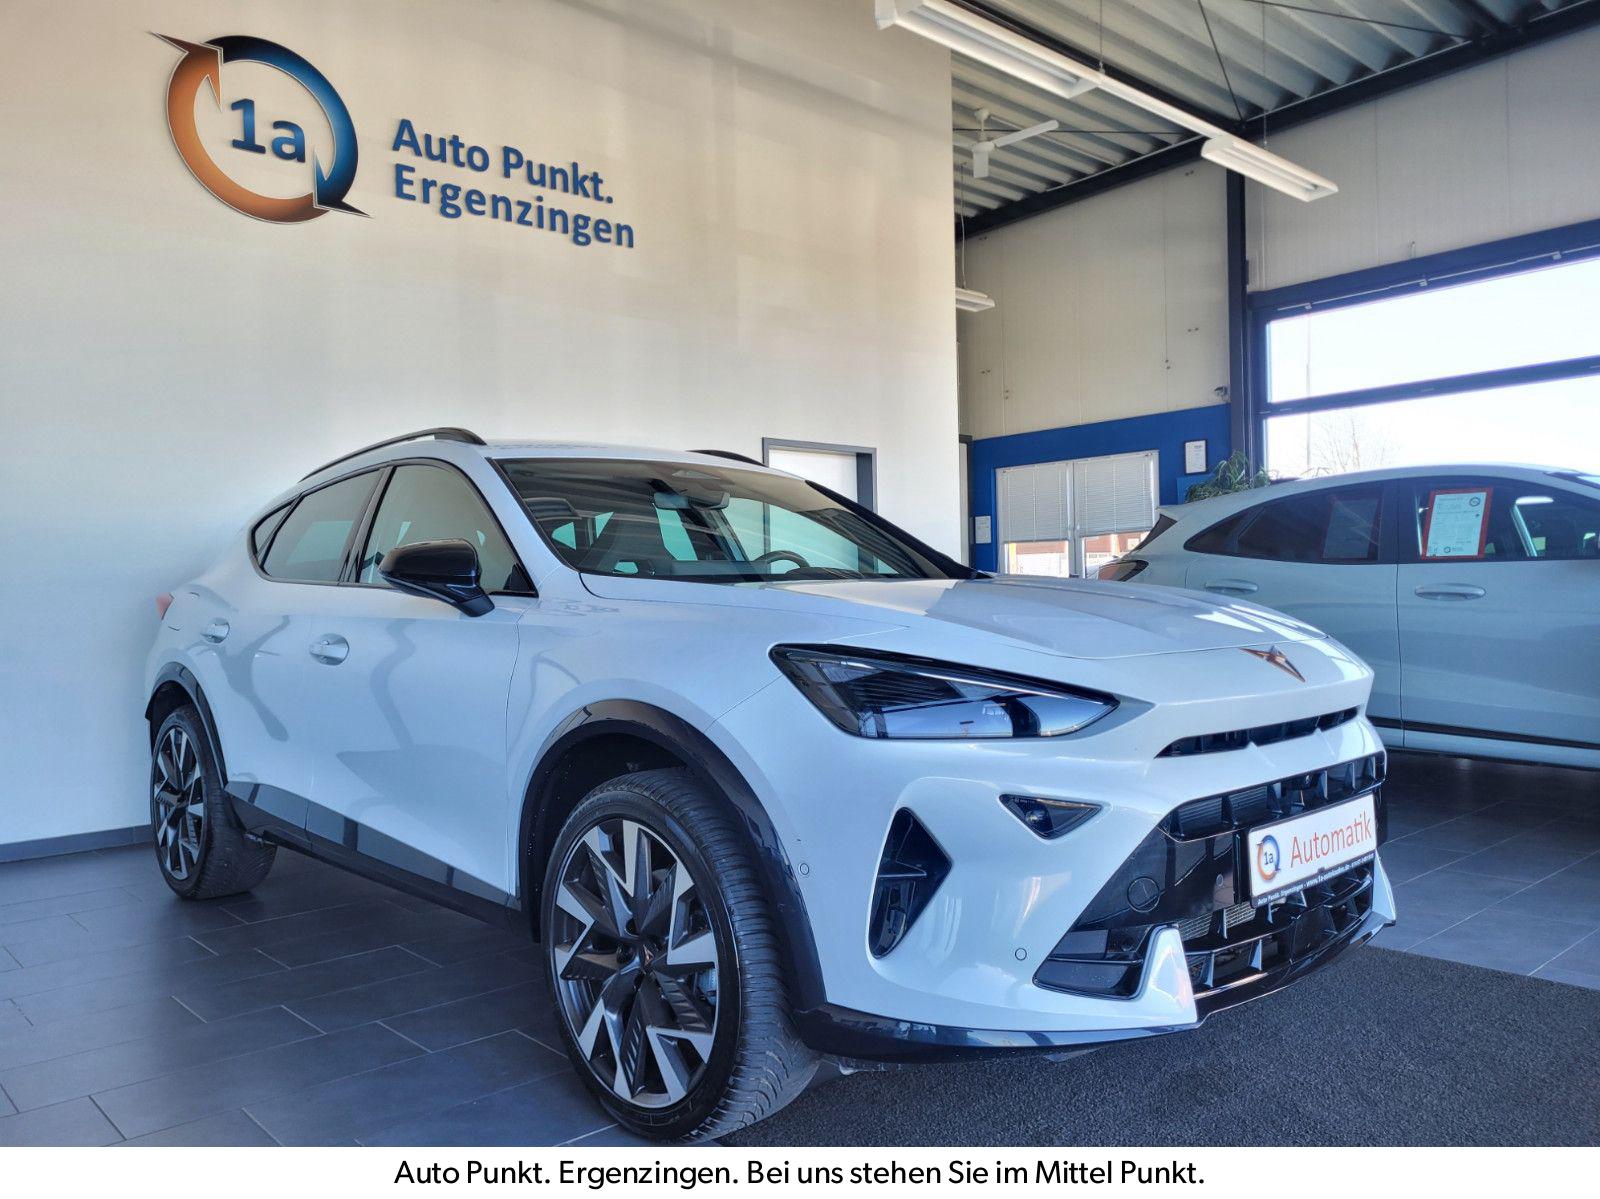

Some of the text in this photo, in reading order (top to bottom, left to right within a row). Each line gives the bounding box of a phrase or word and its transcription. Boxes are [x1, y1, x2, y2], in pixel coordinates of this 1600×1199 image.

[230, 98, 306, 163] 1a
[391, 118, 614, 204] Auto Punkt.
[394, 163, 635, 248] Ergenzingen
[1264, 850, 1274, 866] 1a
[1290, 810, 1372, 868] Automatik
